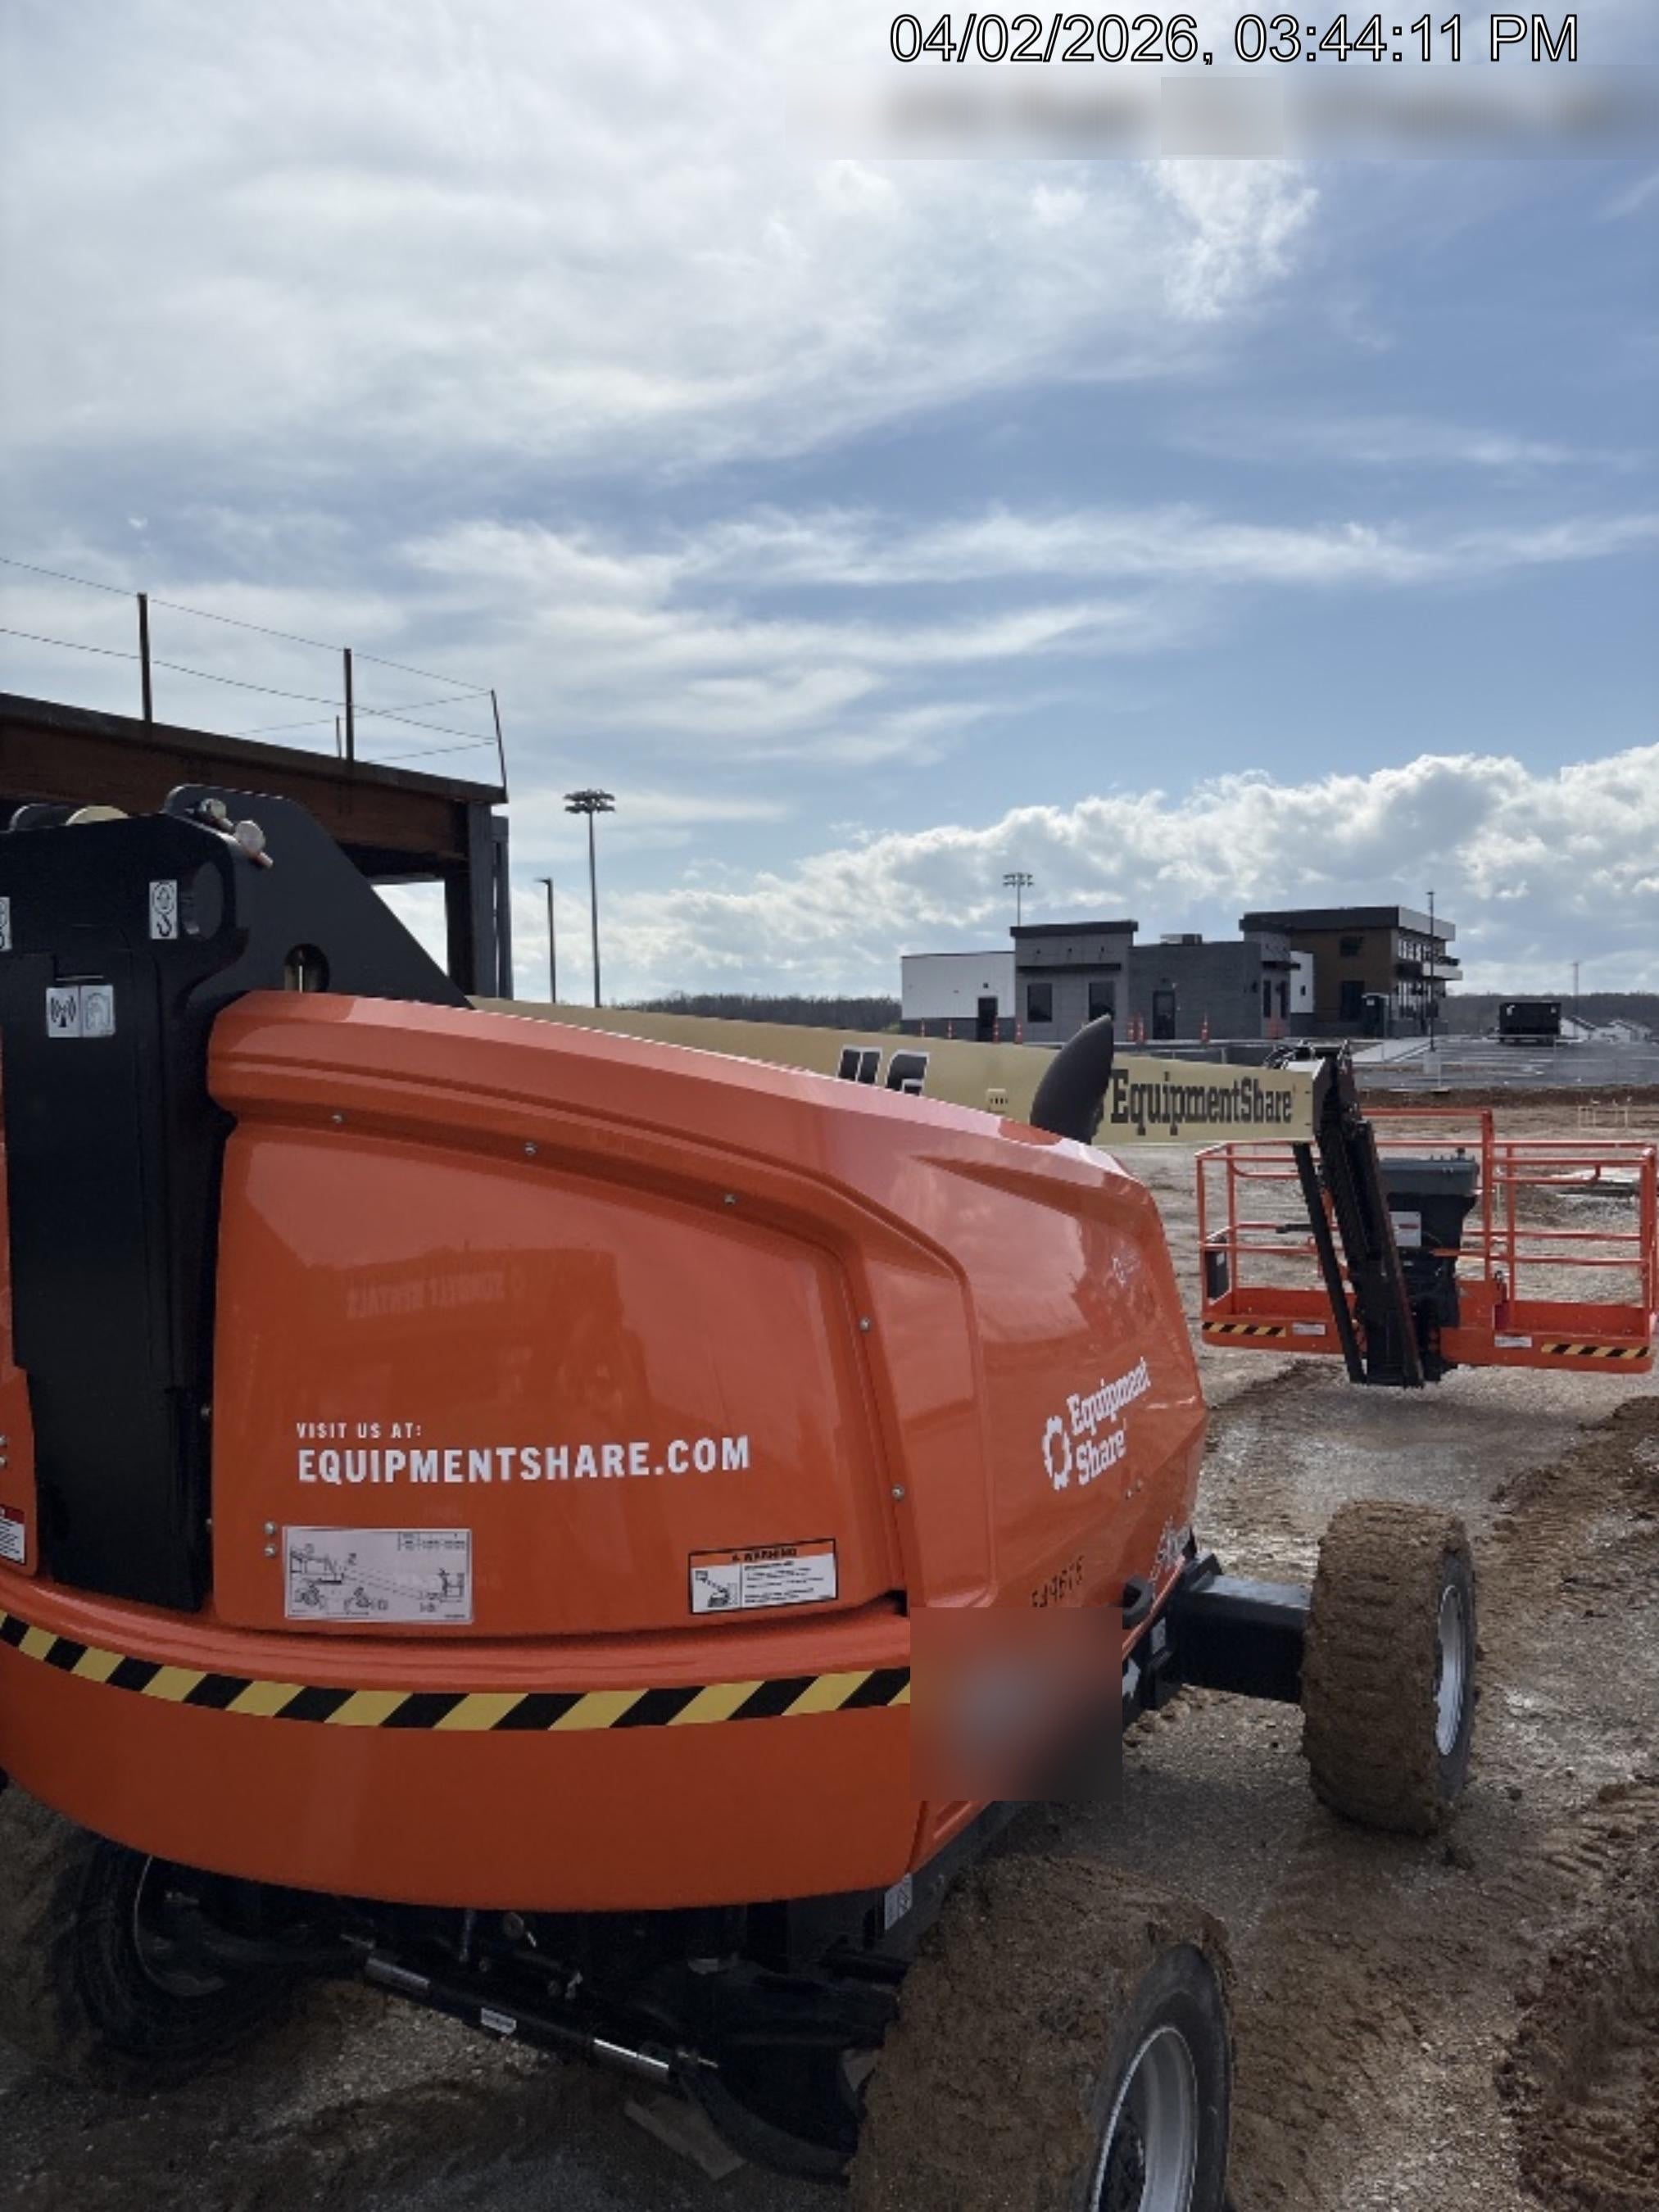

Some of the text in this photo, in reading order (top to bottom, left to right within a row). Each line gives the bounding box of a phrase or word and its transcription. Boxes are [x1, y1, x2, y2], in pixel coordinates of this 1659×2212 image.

[1109, 1068, 1291, 1136] EquipmentShare
[1067, 1357, 1151, 1436] Equipment
[296, 1422, 423, 1439] VISIT US AT:
[1076, 1429, 1126, 1486] Share
[298, 1435, 750, 1484] EQUIPMENTSHARE.COM
